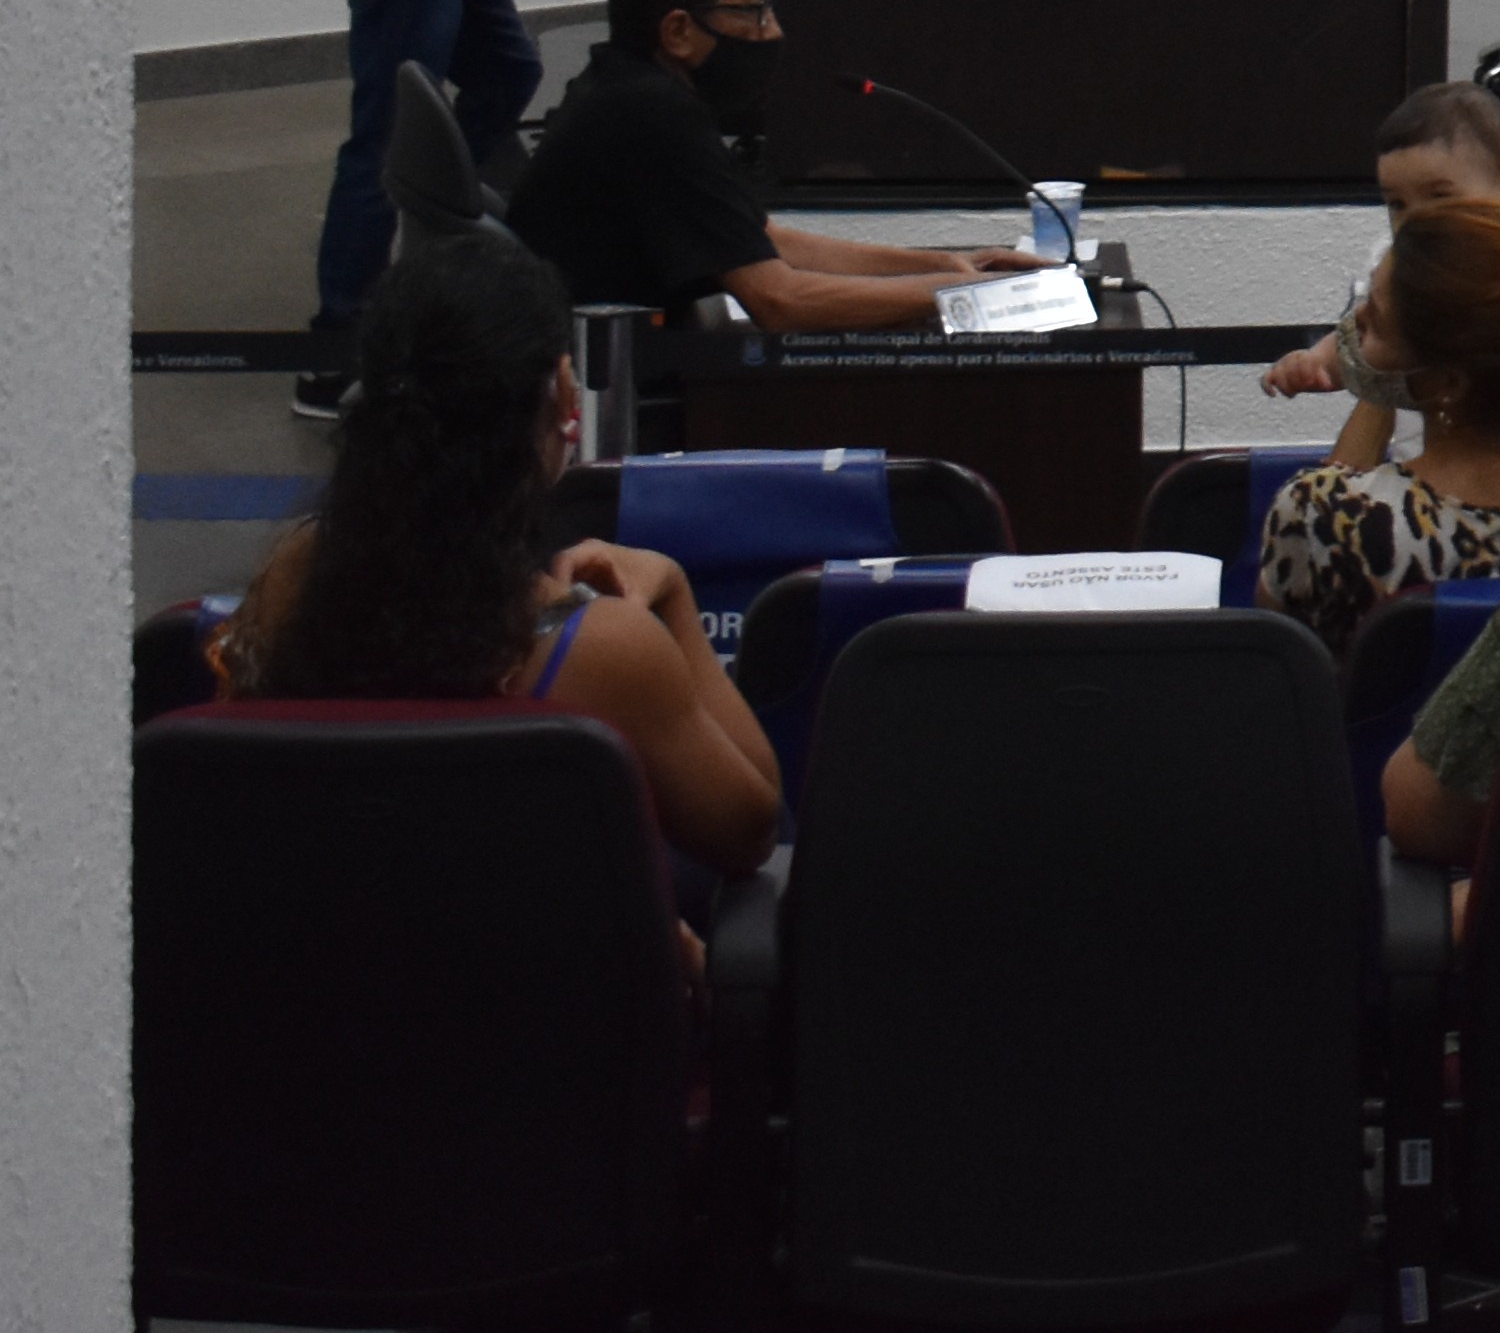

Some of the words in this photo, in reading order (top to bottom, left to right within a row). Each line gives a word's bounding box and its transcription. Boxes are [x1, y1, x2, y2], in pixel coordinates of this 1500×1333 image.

[782, 333, 841, 345] Câmara
[844, 333, 921, 347] Municipal
[924, 333, 943, 345] de
[781, 353, 834, 367] Acesso
[837, 352, 896, 366] restrito
[900, 353, 954, 368] apenas
[957, 352, 993, 367] para
[997, 349, 1092, 364] funcionários
[1096, 352, 1103, 362] e
[1026, 565, 1116, 579] ASSENTO
[1121, 564, 1167, 573] ESTE
[1069, 573, 1110, 586] NÃO
[1115, 573, 1179, 582] FAVOR
[1012, 580, 1064, 589] USAR
